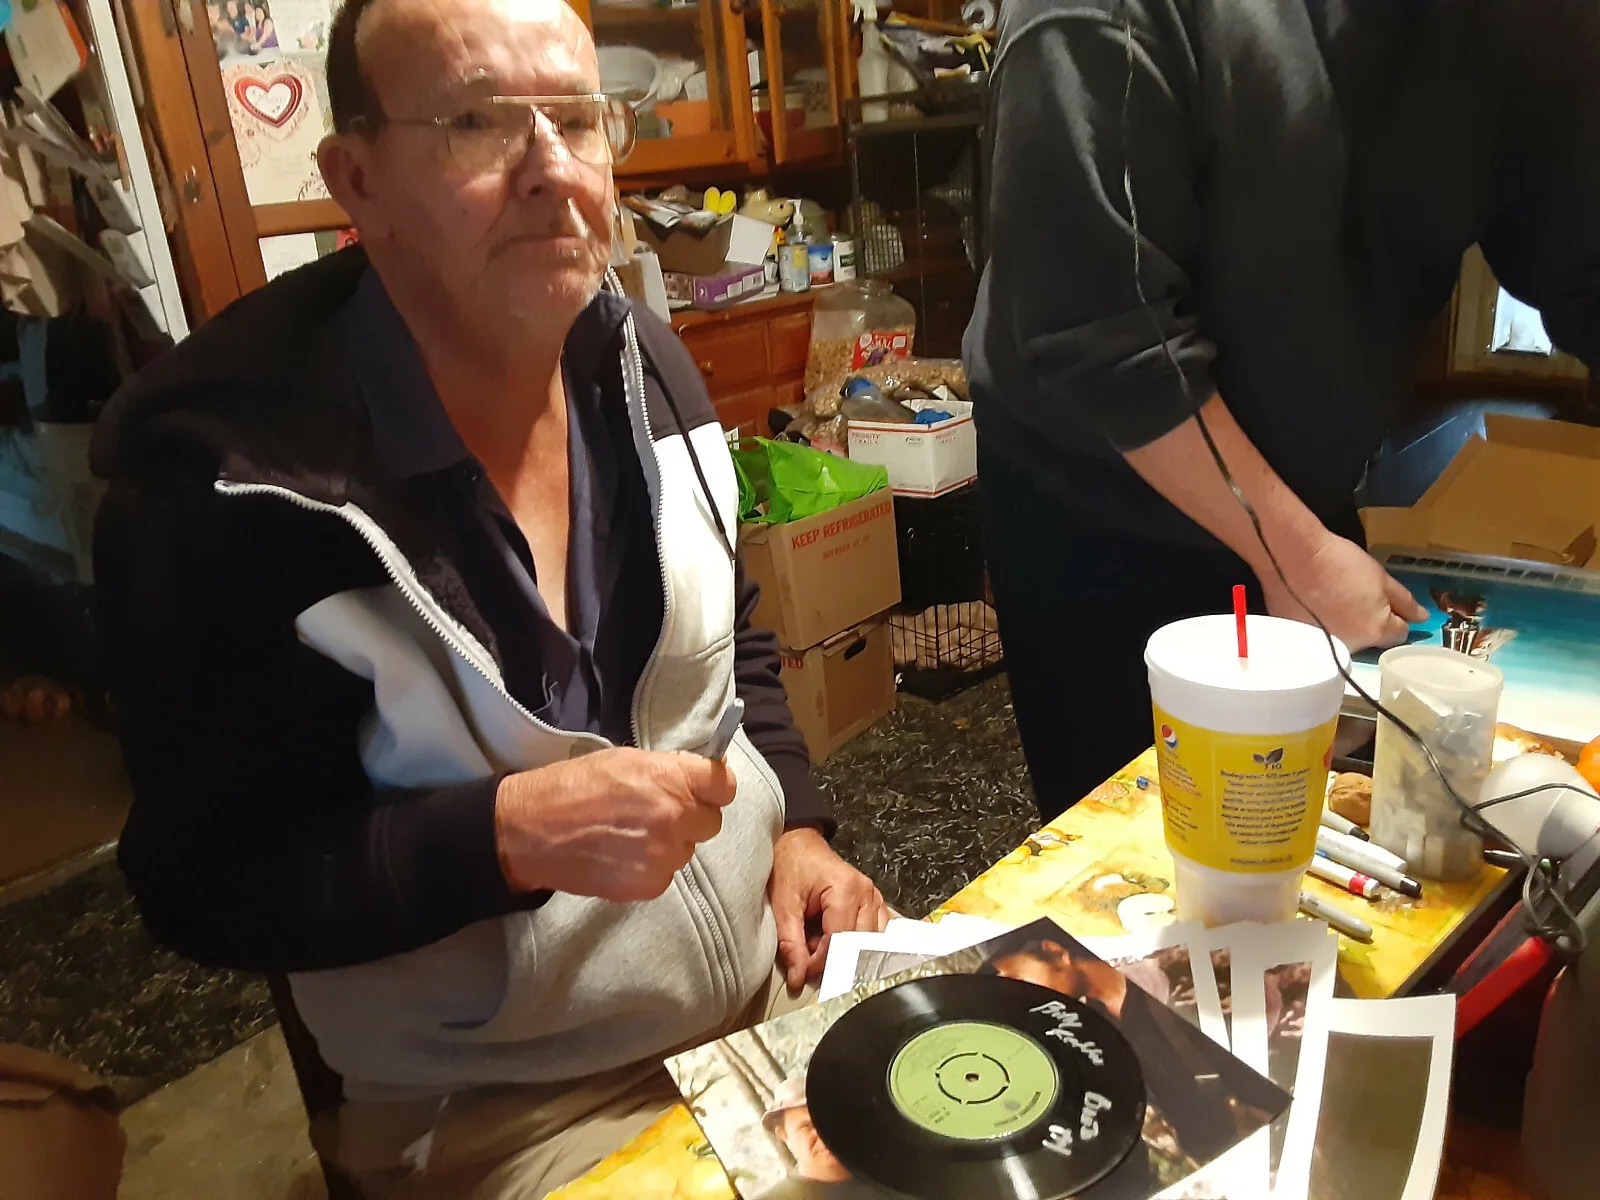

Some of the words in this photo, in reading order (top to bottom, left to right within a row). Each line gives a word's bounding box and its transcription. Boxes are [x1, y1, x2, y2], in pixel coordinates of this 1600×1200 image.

[851, 431, 880, 440] PRIORITY
[791, 529, 820, 550] KEEP
[823, 501, 892, 538] REFRIGERATED
